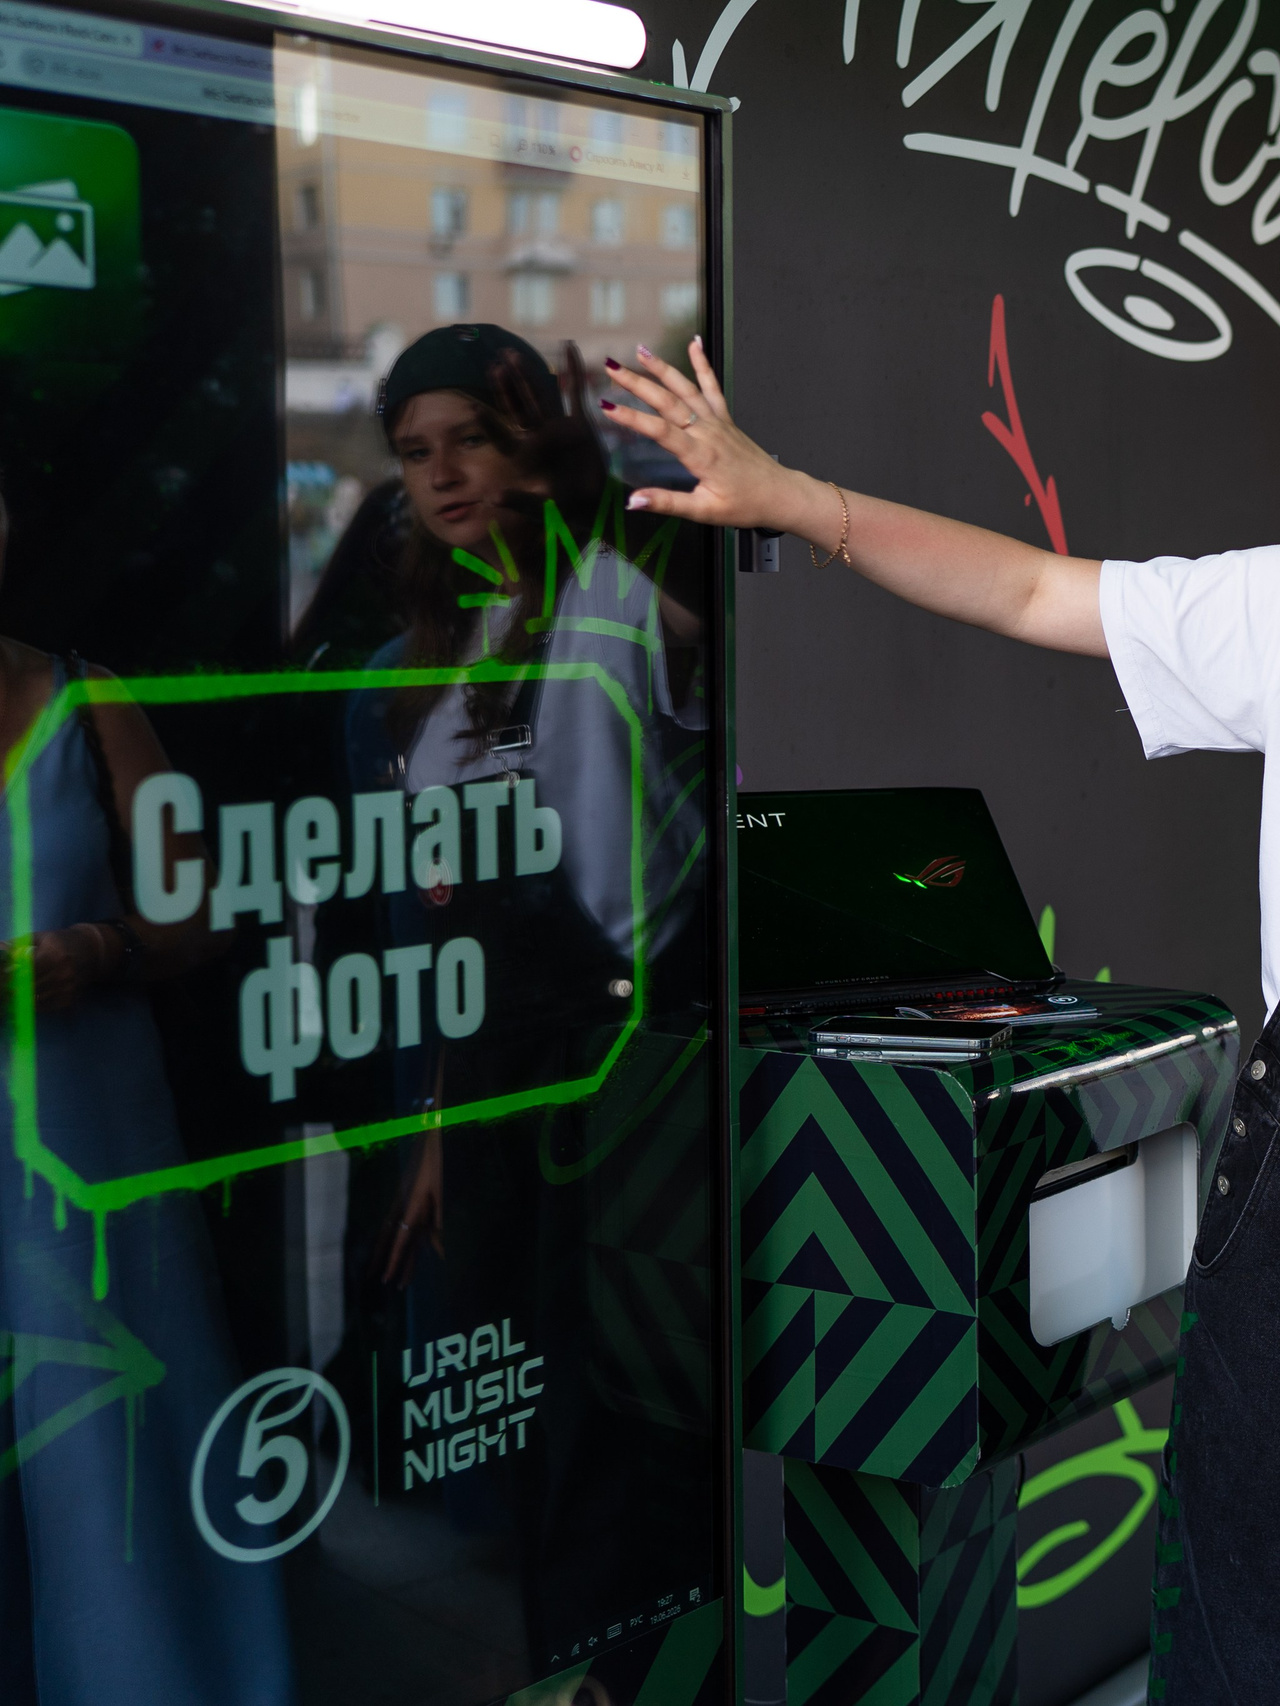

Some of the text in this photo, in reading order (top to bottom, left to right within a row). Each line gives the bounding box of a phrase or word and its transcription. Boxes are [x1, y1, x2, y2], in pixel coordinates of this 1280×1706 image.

[131, 772, 562, 932] Сделать
[239, 936, 486, 1103] фото
[402, 1317, 526, 1388] URAL
[403, 1355, 545, 1441] MUSIC
[234, 1376, 317, 1526] 5
[403, 1406, 536, 1491] NIGHT
